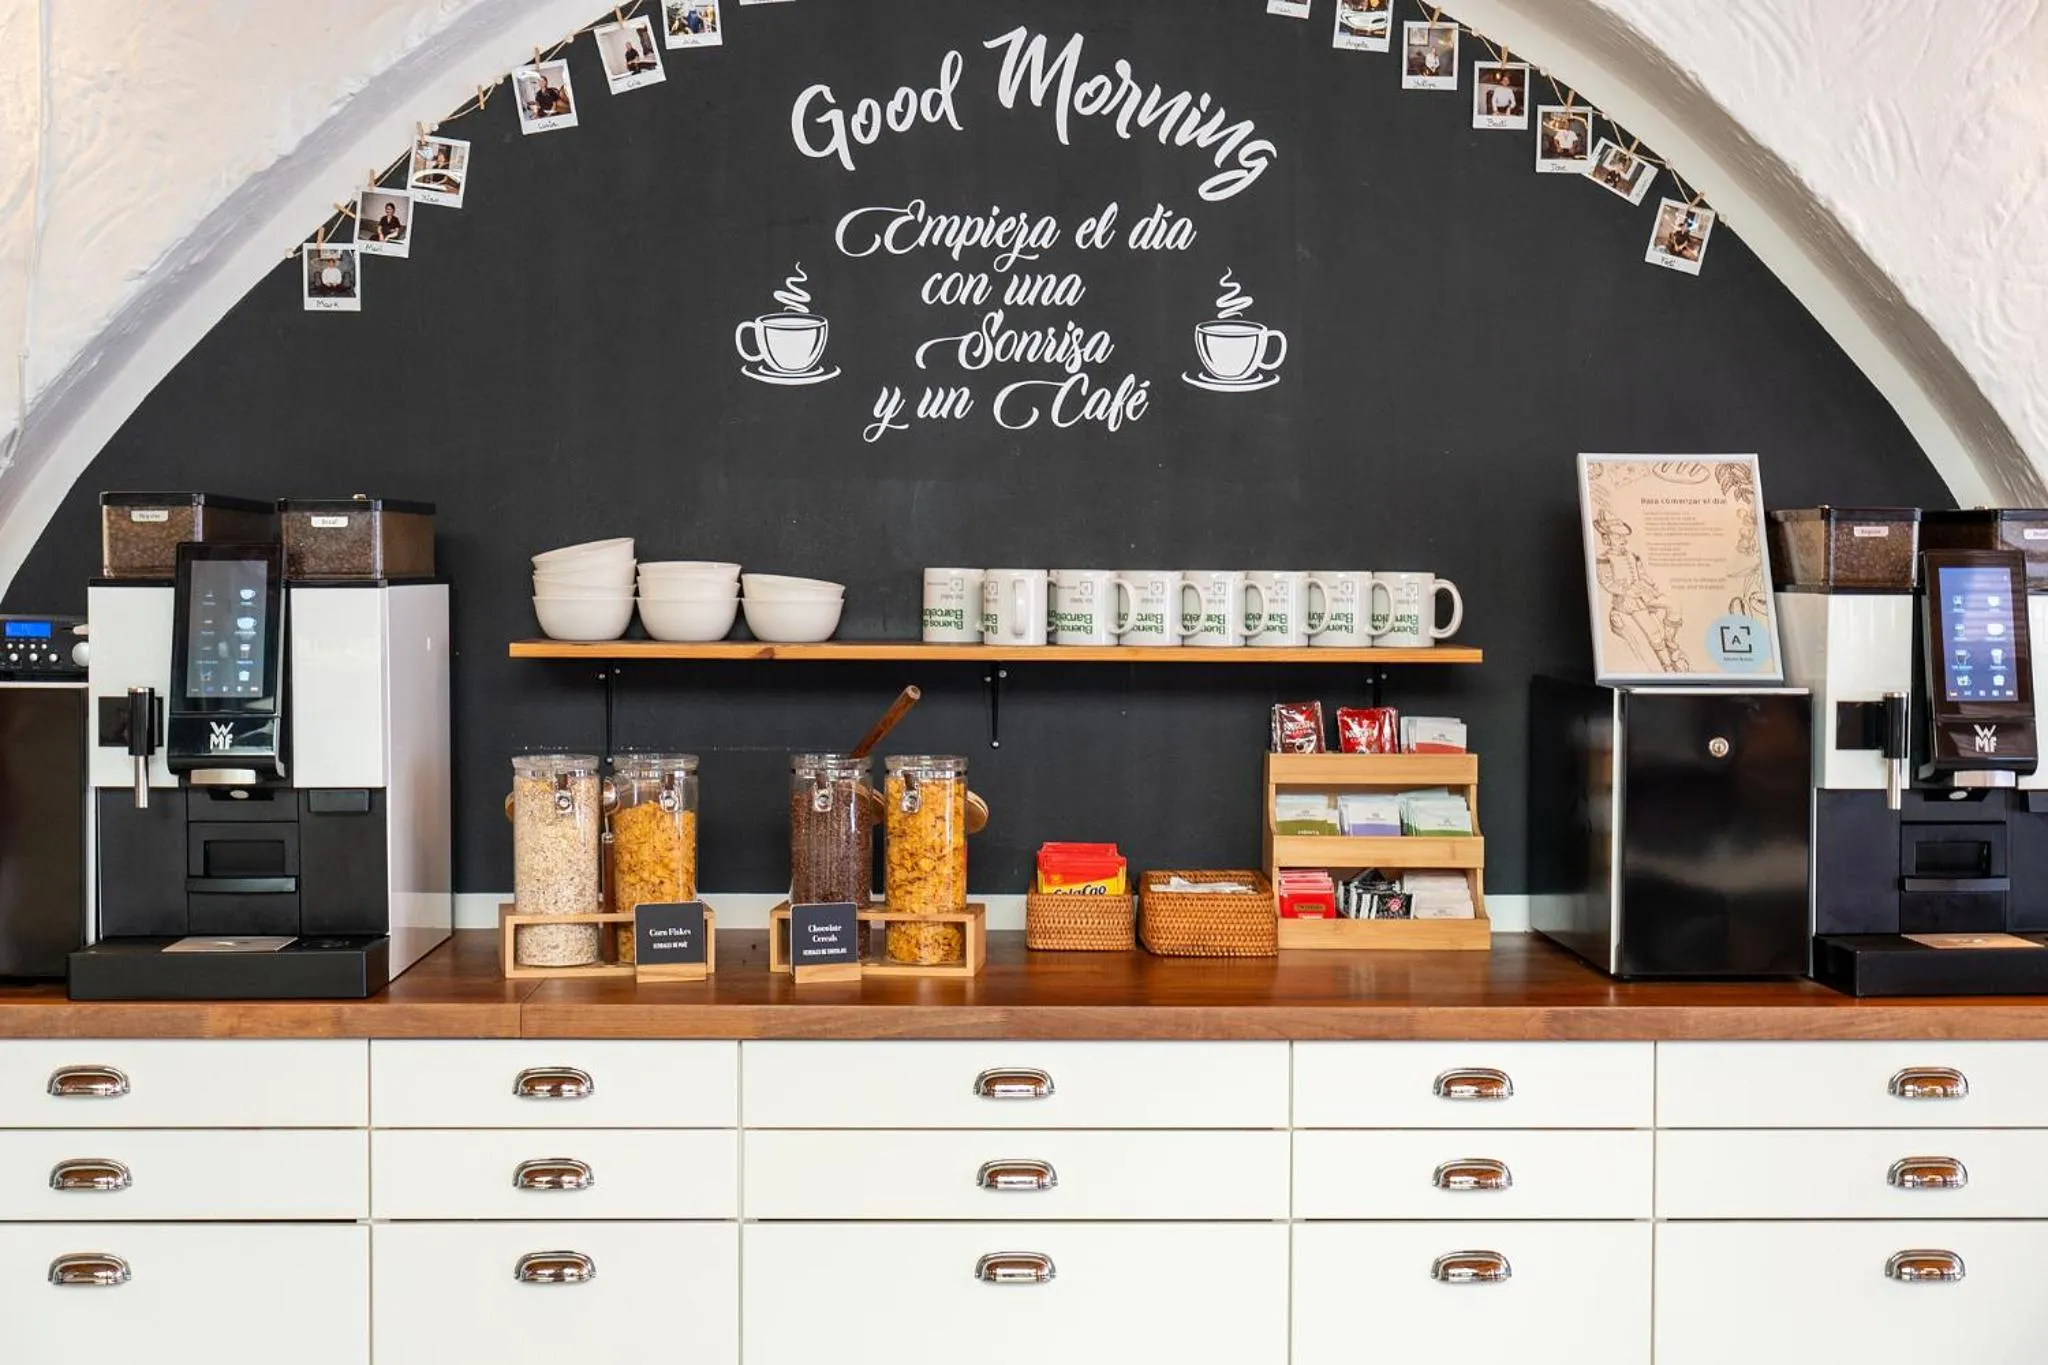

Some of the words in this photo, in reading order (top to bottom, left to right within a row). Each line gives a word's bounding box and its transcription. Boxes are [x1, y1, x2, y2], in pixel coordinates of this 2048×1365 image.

[791, 50, 964, 171] Good
[983, 26, 1277, 201] Morning
[835, 199, 1060, 272] Empieza
[1075, 202, 1118, 250] el
[921, 272, 992, 306] con
[1004, 273, 1086, 306] una
[915, 309, 1114, 374] Sonrisa
[863, 386, 909, 442] y
[917, 387, 974, 419] un
[993, 373, 1150, 432] Café
[649, 929, 668, 937] Corn
